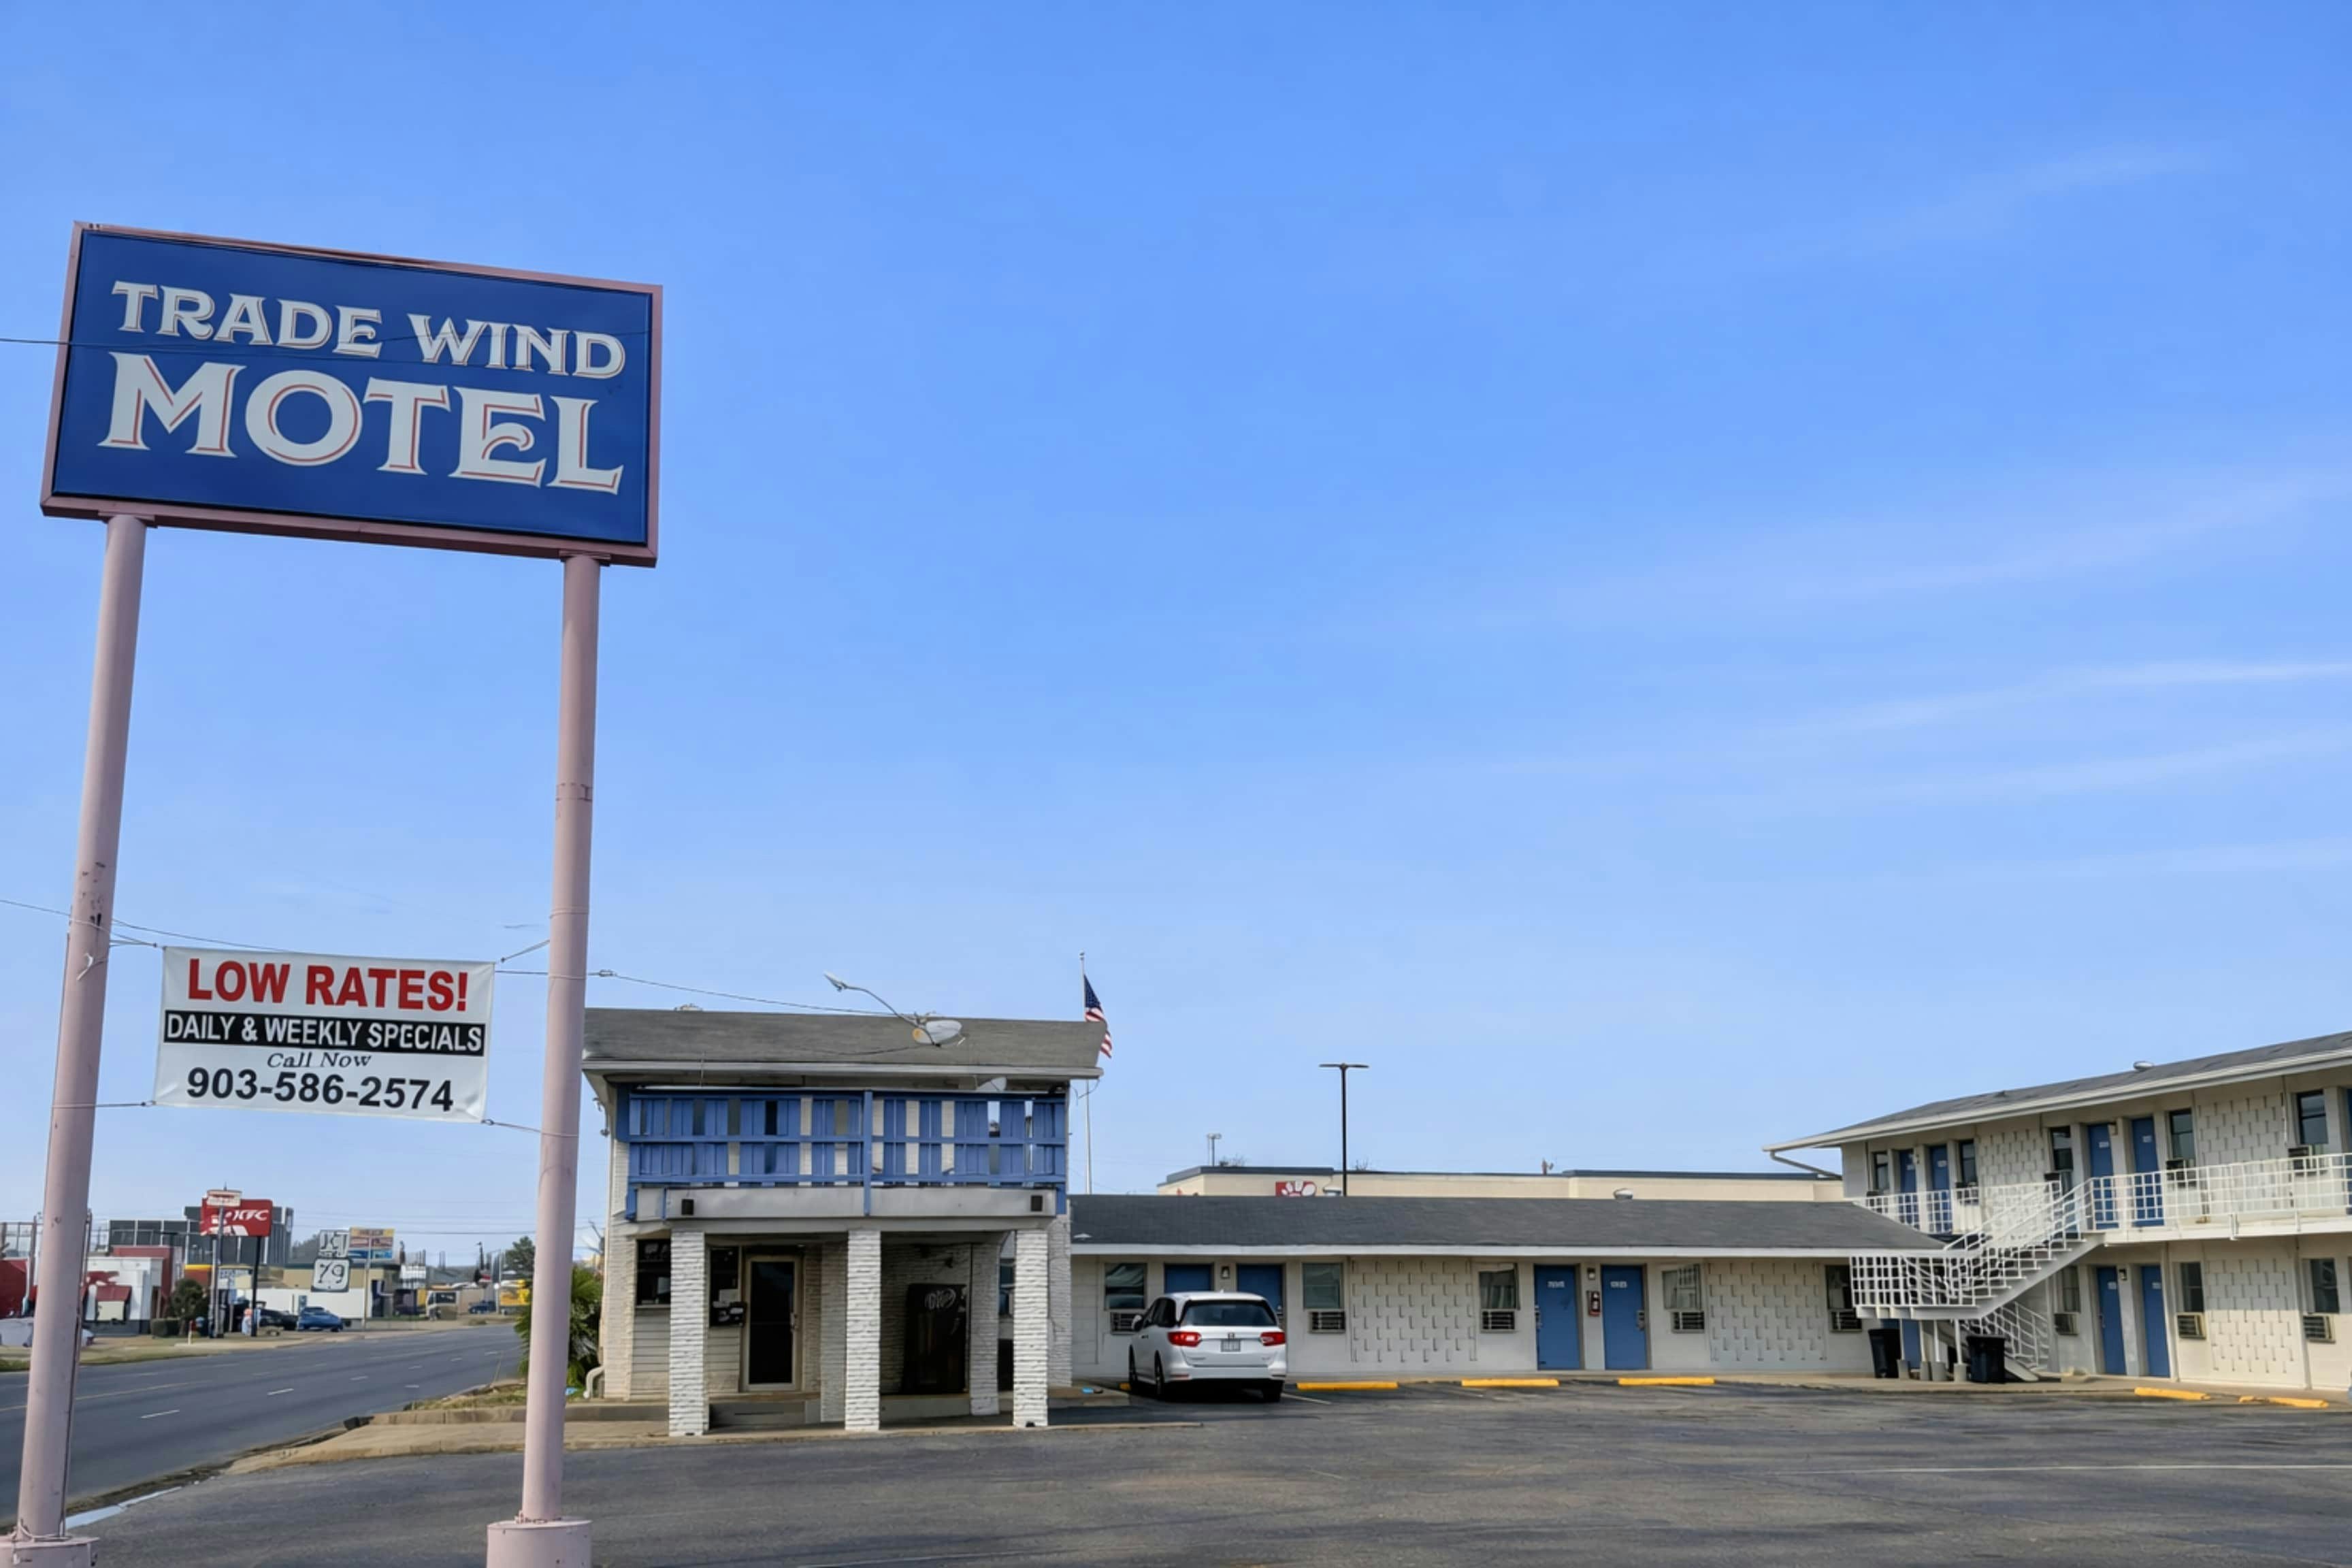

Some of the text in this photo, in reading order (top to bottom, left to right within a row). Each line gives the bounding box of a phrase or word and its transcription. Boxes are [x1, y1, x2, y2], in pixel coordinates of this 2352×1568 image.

[112, 280, 626, 379] TRADE WIND
[97, 352, 625, 495] MOTEL
[188, 958, 469, 1012] LOW RATES!
[167, 1013, 482, 1052] DAILY & WEEKLY SPECIALS
[266, 1051, 372, 1068] Call Now
[187, 1066, 454, 1112] 903-586-2574
[233, 1209, 269, 1221] KFC
[318, 1262, 346, 1284] 79
